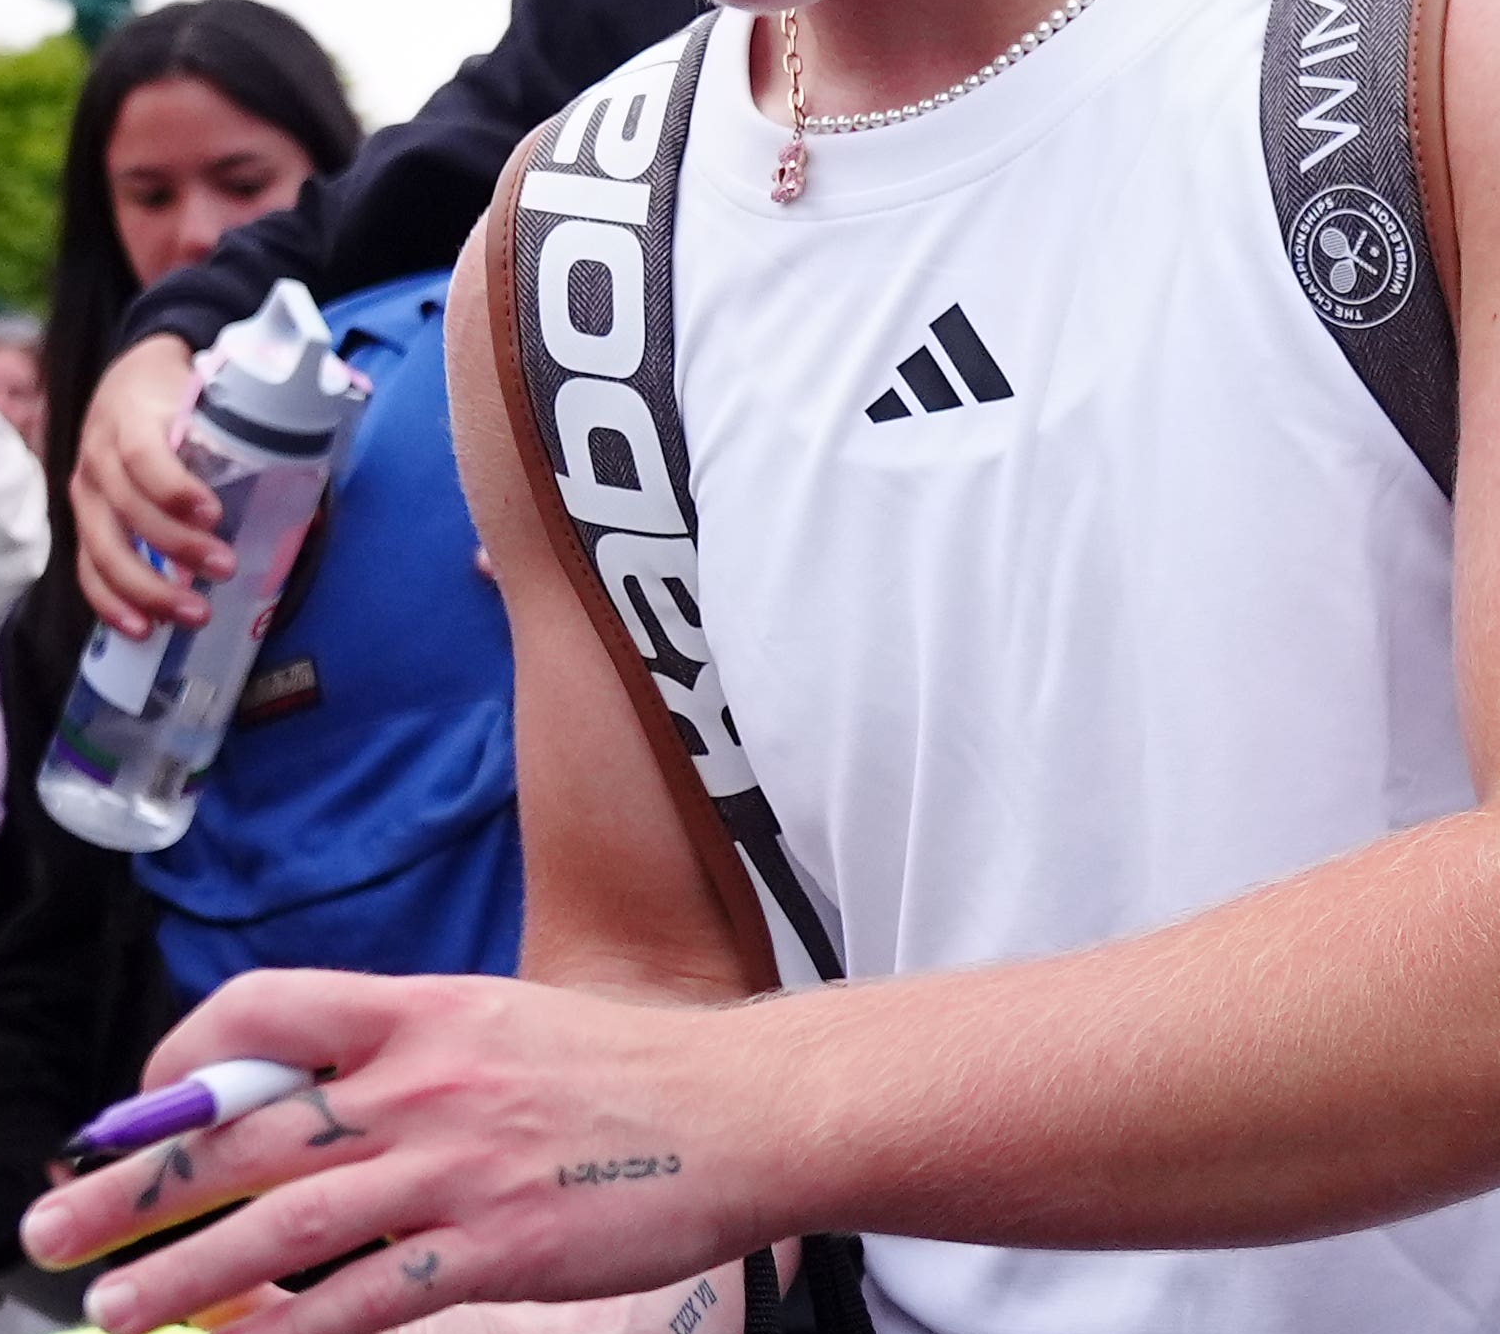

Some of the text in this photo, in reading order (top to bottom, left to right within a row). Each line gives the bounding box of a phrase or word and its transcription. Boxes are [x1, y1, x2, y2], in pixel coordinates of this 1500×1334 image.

[1295, 197, 1364, 321] THE CHAMPIONSHIPS
[1368, 202, 1409, 296] WIMBLEDON
